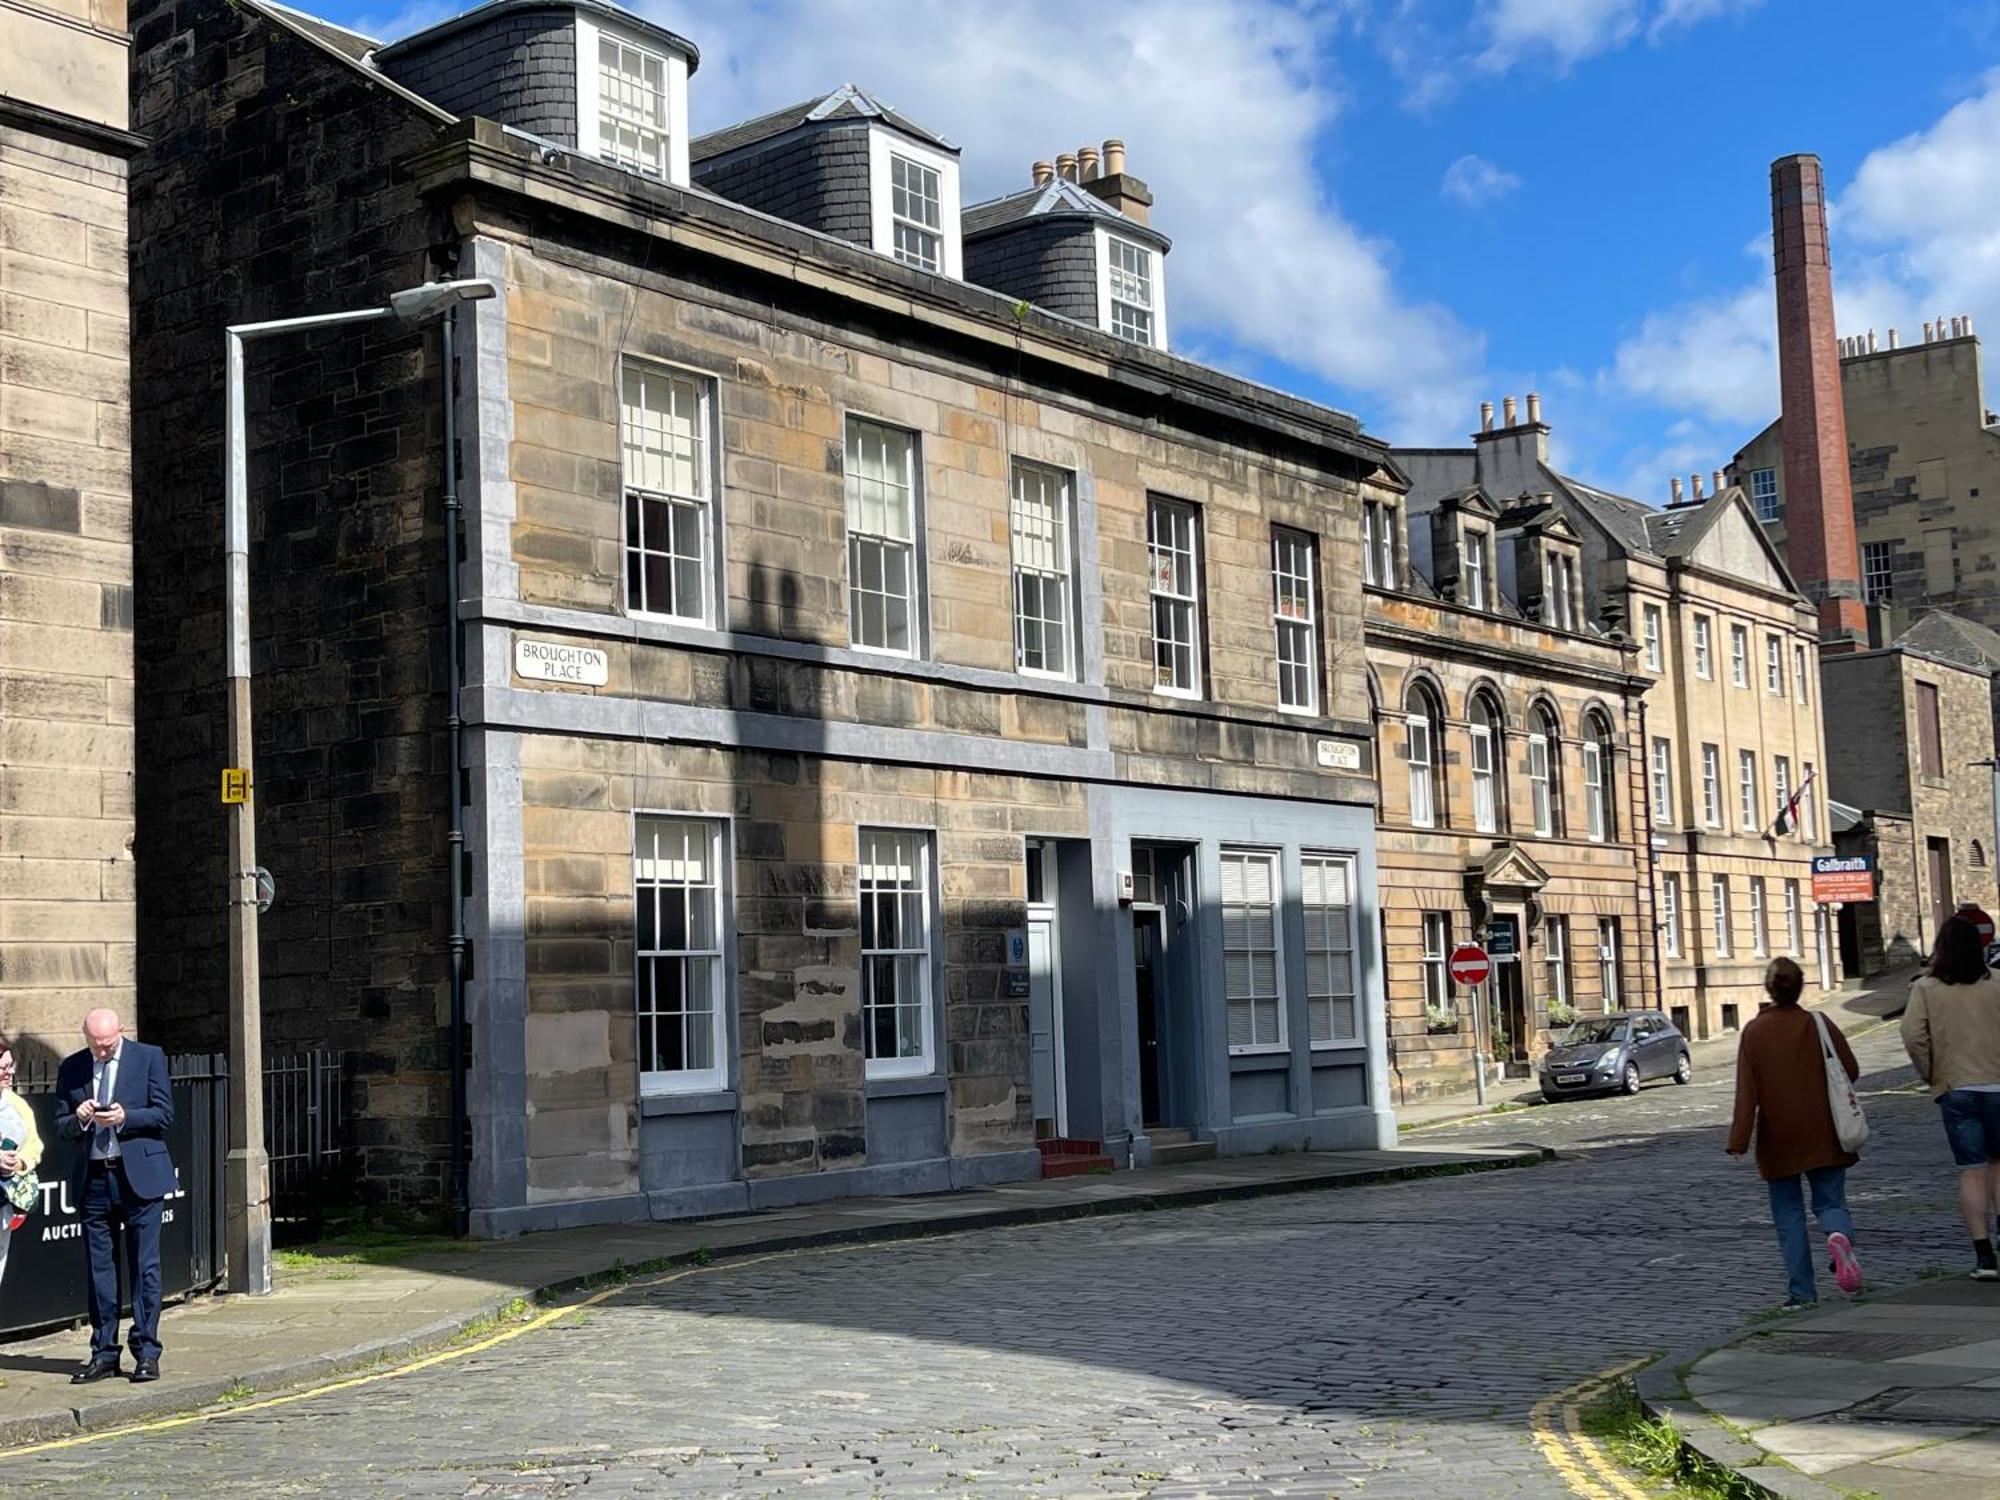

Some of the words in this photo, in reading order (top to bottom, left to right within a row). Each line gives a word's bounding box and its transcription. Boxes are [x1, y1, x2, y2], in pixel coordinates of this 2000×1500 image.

[523, 643, 602, 667] BROUGHTON
[544, 662, 583, 680] PLACE
[1817, 858, 1866, 872] Galbraith
